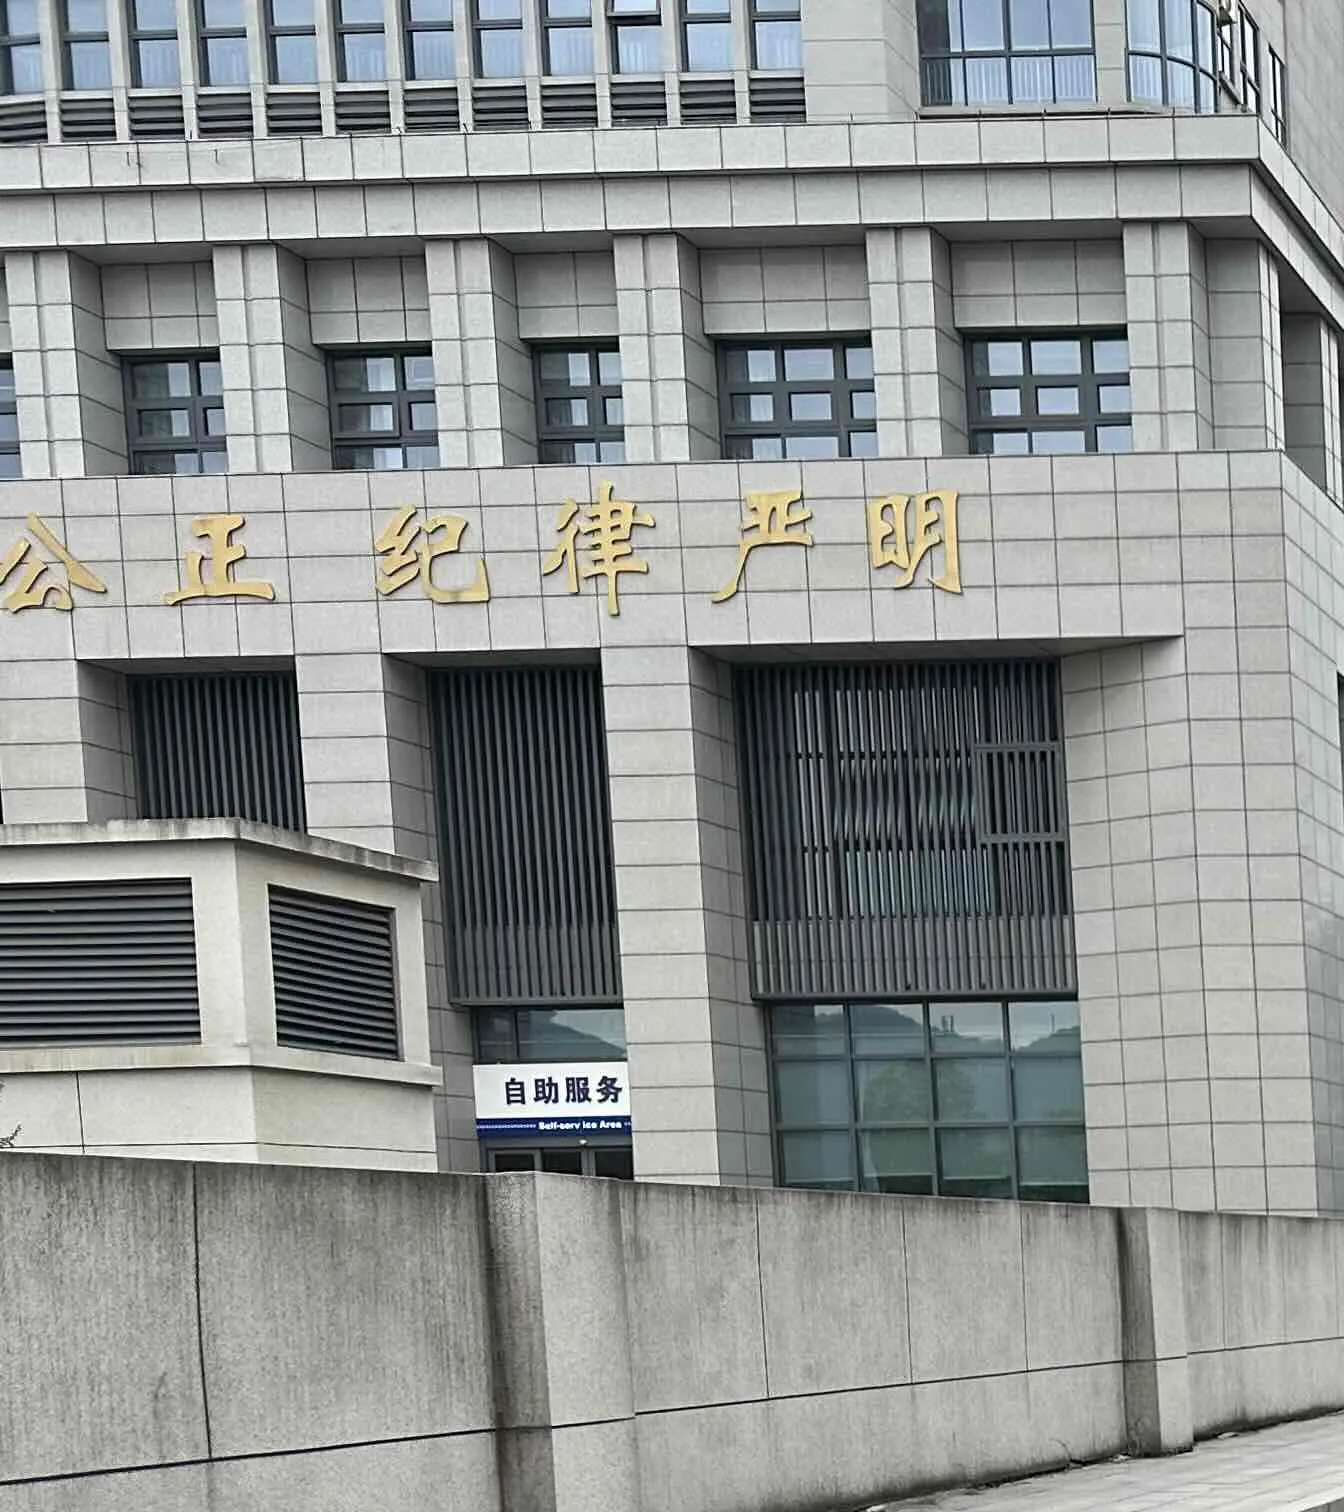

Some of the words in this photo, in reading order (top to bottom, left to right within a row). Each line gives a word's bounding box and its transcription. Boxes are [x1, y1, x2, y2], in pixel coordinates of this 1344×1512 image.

[504, 1075, 624, 1105] 自助服务
[599, 1120, 623, 1130] Area
